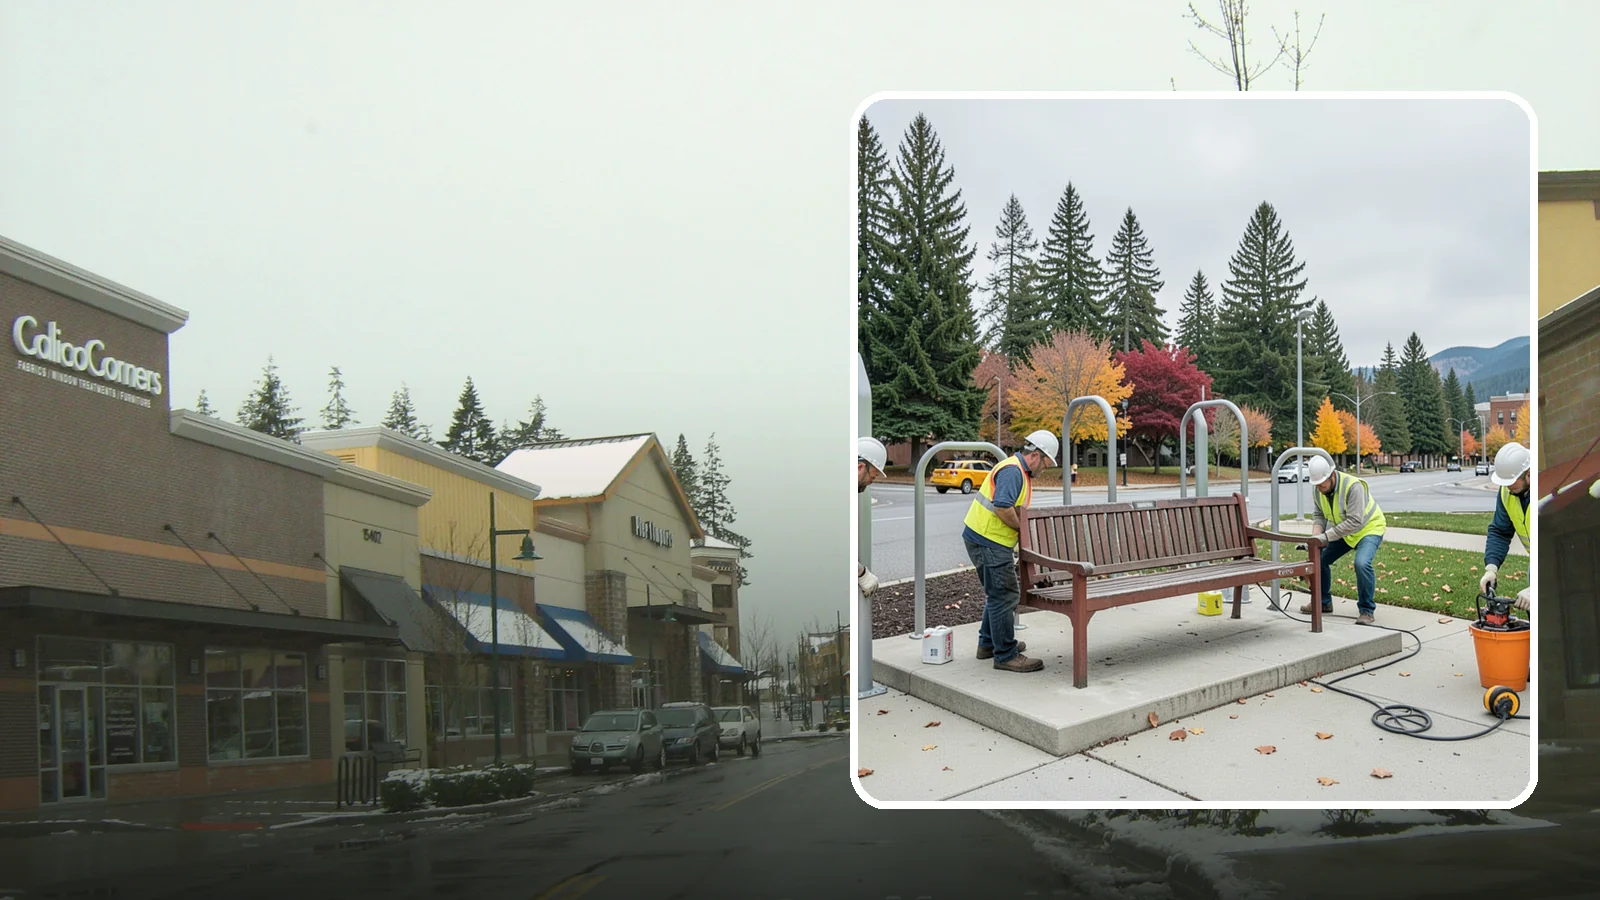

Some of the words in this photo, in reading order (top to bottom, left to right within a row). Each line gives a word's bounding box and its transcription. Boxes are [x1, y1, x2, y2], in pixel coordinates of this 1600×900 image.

[16, 359, 47, 377] FABRICS
[51, 369, 78, 387] WINDOW
[78, 378, 117, 398] TREATMENTS
[120, 390, 151, 409] FURNITURE
